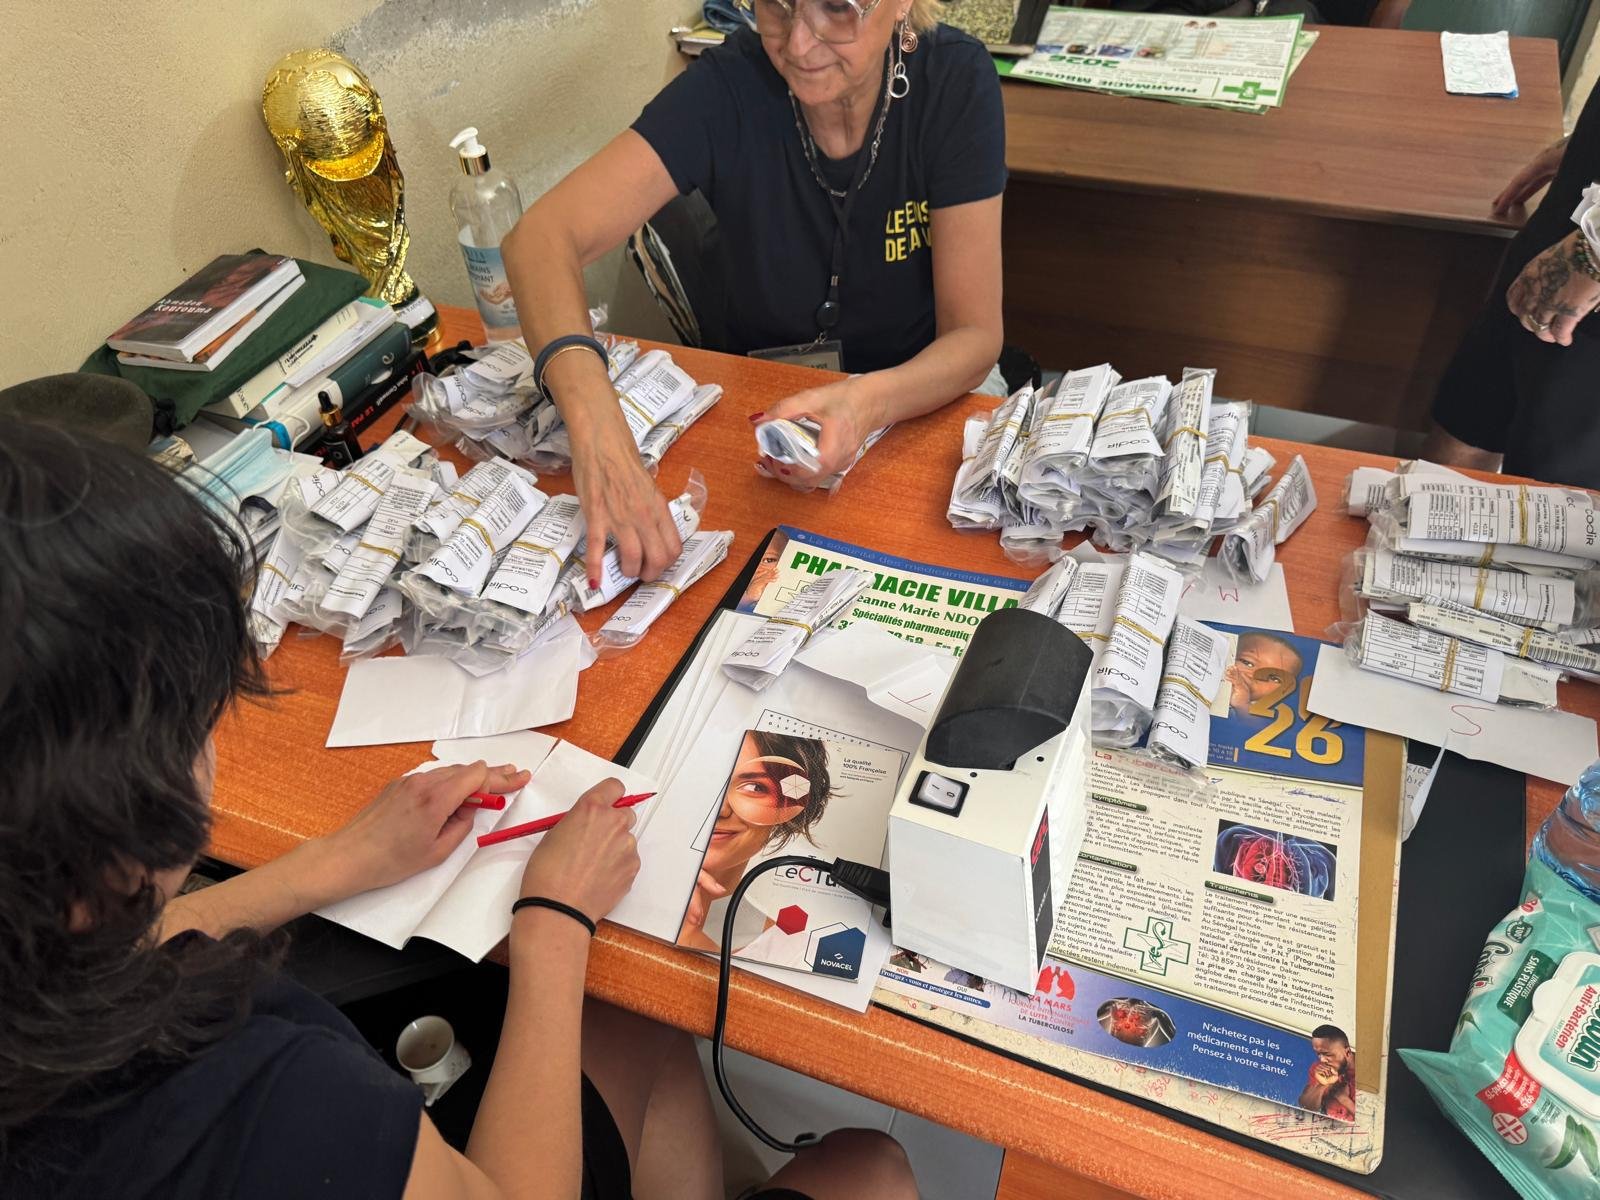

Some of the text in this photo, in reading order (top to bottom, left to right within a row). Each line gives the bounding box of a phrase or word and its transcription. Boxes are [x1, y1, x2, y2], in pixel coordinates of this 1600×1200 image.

[885, 237, 908, 262] DE
[790, 551, 1020, 613] PHAACIE VILLA
[852, 608, 904, 628] Spécialités
[902, 619, 971, 644] pharmaceutiq
[856, 594, 984, 628] eanne Marie NDO
[1244, 703, 1344, 765] 26
[851, 757, 872, 768] qualité
[820, 958, 854, 972] NOVACEL
[1503, 955, 1540, 1009] SANS PLASTIQUE
[929, 983, 954, 999] protégez
[1043, 997, 1073, 1012] MARS
[1018, 1014, 1075, 1035] LA TUBERCULOSE
[1556, 985, 1598, 1049] Anti-Bactérien
[1187, 1030, 1295, 1068] médicaments de la rue,
[1202, 1021, 1281, 1050] N'achetez pas les
[1192, 1043, 1290, 1077] Pensez à votre santé.
